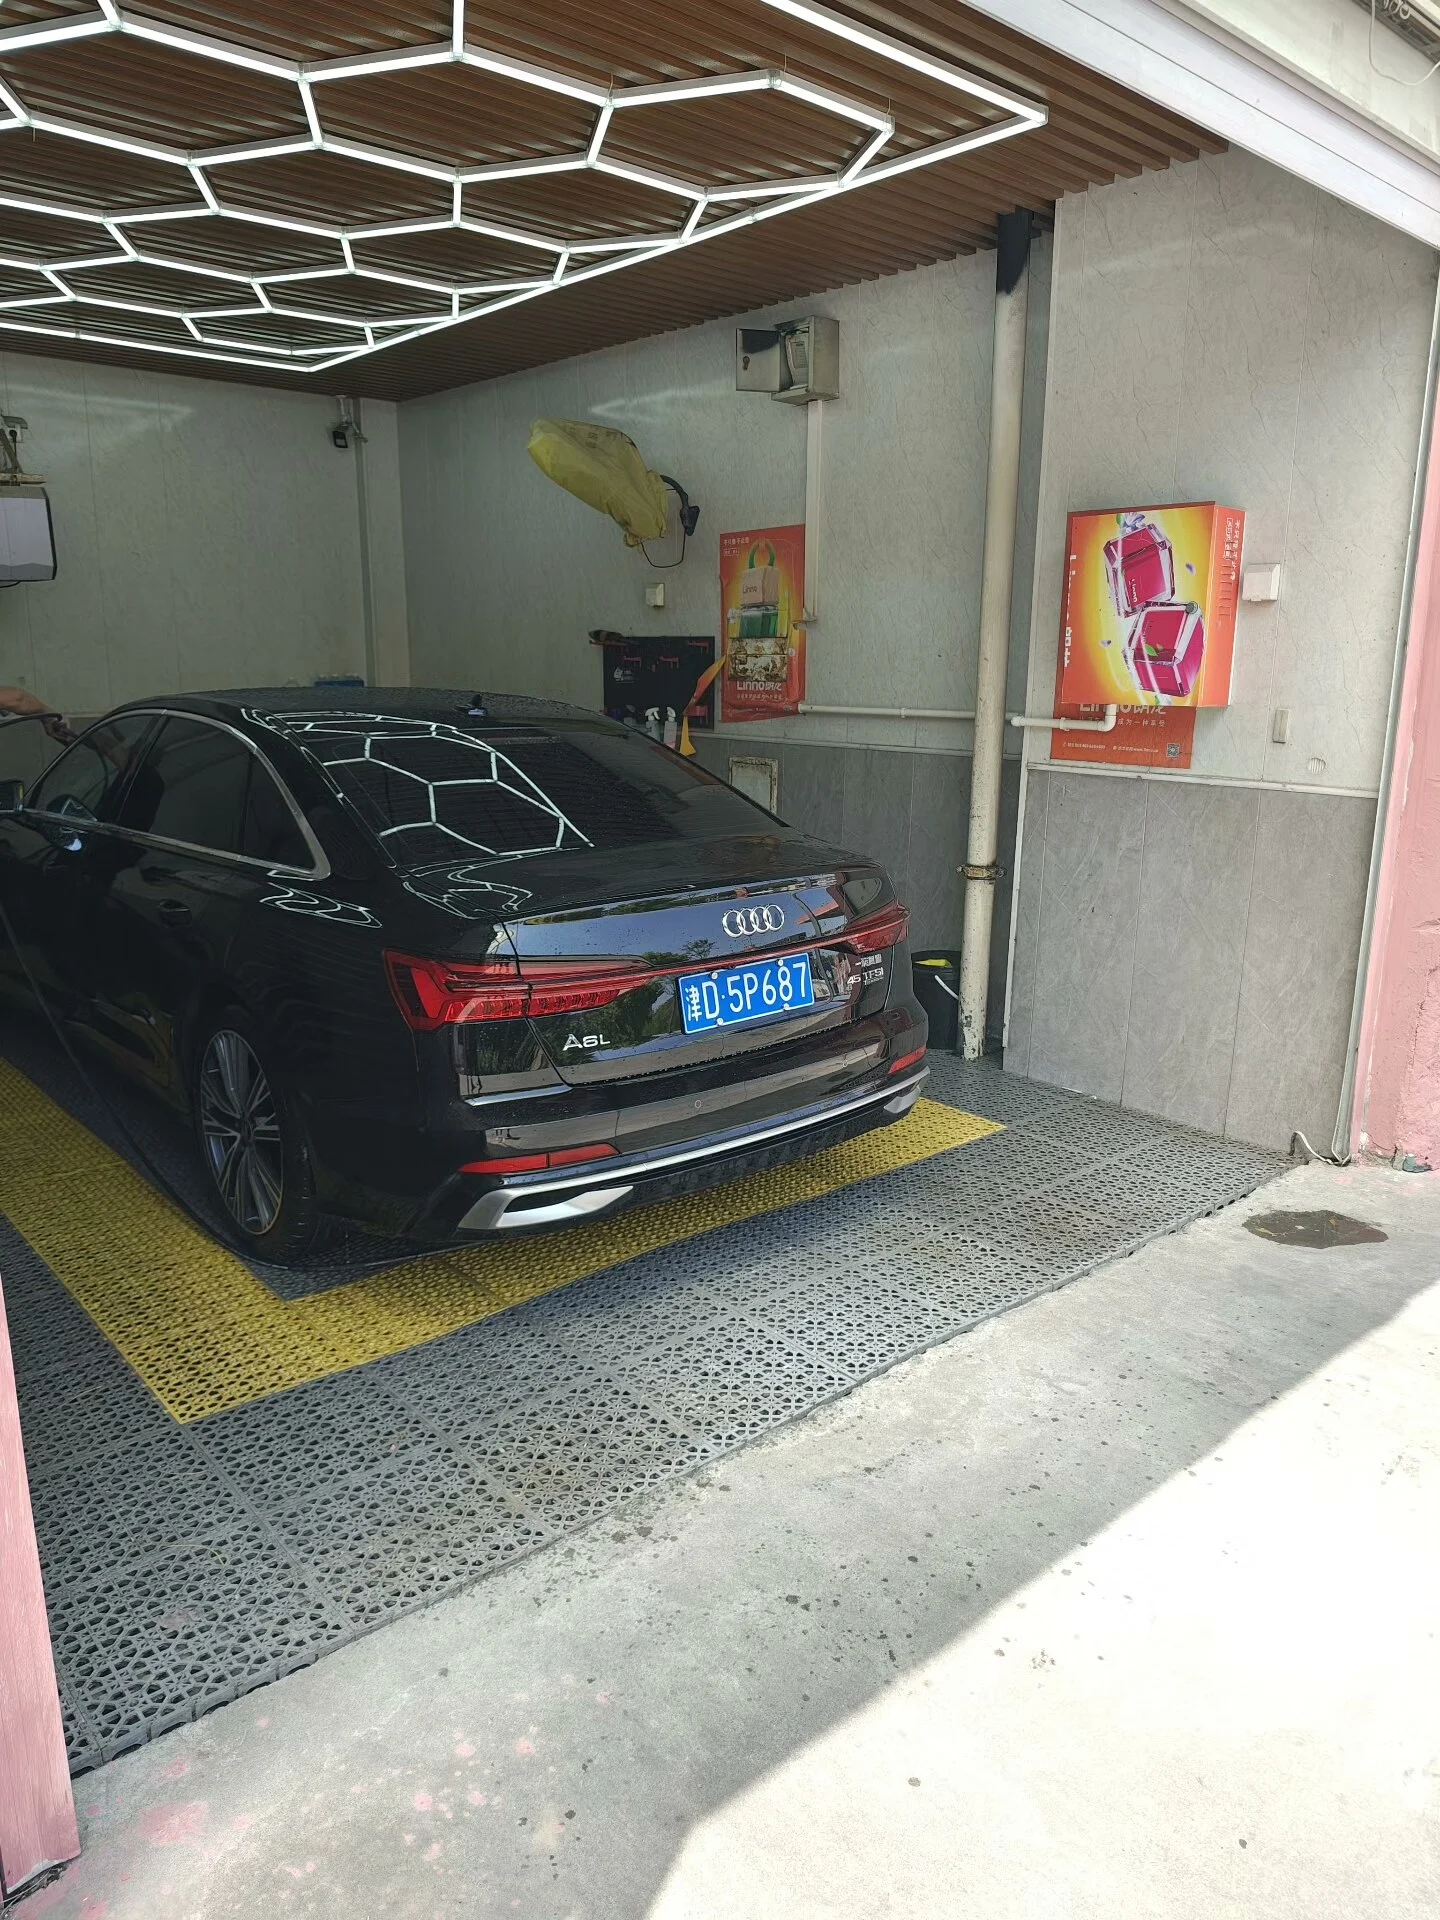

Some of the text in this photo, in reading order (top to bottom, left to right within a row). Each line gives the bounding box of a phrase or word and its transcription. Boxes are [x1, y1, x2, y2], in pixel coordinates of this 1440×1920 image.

[847, 973, 862, 985] 45
[862, 966, 884, 980] TFSI
[562, 1033, 611, 1051] A6L
